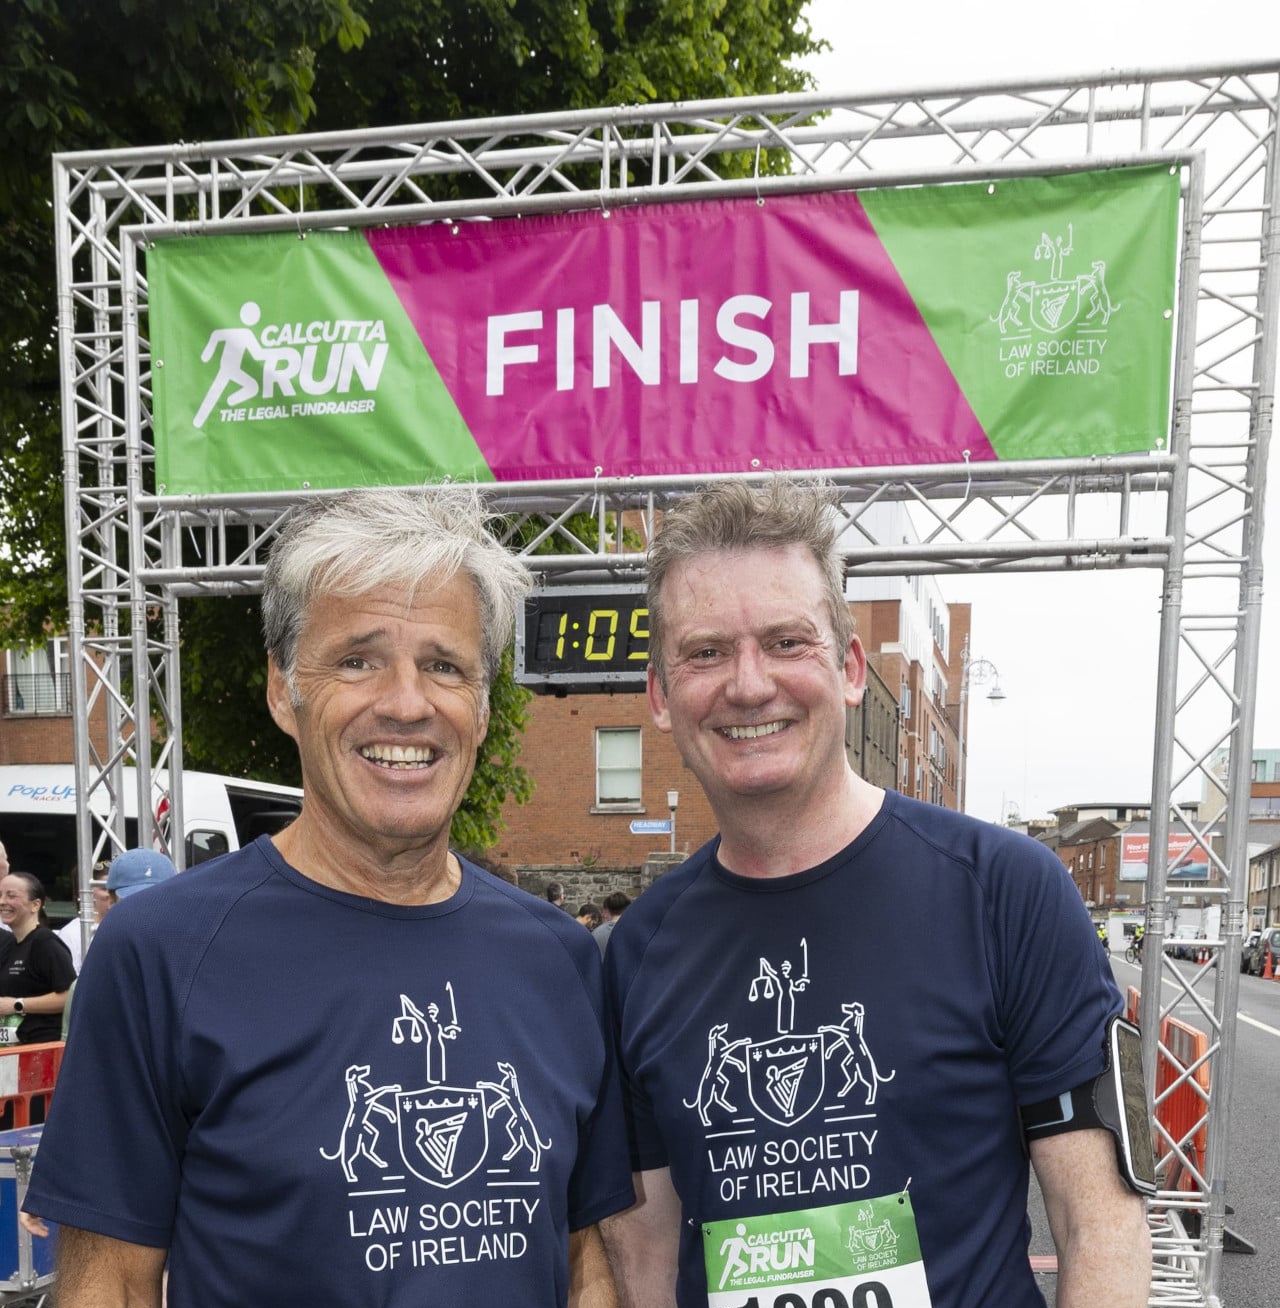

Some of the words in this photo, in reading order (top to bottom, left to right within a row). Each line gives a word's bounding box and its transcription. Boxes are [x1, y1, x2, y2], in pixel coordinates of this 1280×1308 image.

[260, 319, 387, 347] CALCUTTA
[485, 290, 859, 396] FINISH
[999, 343, 1033, 362] LAW
[1036, 338, 1108, 357] SOCIETY
[261, 342, 389, 399] RUN
[1005, 361, 1027, 378] OF
[1030, 358, 1100, 376] IRELAND
[219, 408, 246, 423] THE
[247, 405, 289, 421] LEGAL
[291, 399, 375, 417] FUNDRAISER
[7, 784, 48, 798] Pop
[707, 1144, 757, 1173] LAW
[763, 1129, 878, 1166] SOCIETY
[719, 1175, 749, 1202] OF
[756, 1163, 871, 1198] IRELAND
[349, 1206, 409, 1237] LAW
[419, 1198, 540, 1231] SOCIETY
[747, 1227, 814, 1247] CALCUTTA
[365, 1241, 403, 1272] OF
[411, 1232, 528, 1267] IRELAND
[749, 1238, 816, 1273] RUN
[856, 1262, 867, 1271] OF
[867, 1257, 898, 1270] IRELAND
[868, 1249, 898, 1262] SOCIETY
[729, 1278, 743, 1287] THE
[743, 1275, 766, 1285] LEGAL
[766, 1269, 815, 1283] FUNDRAISER
